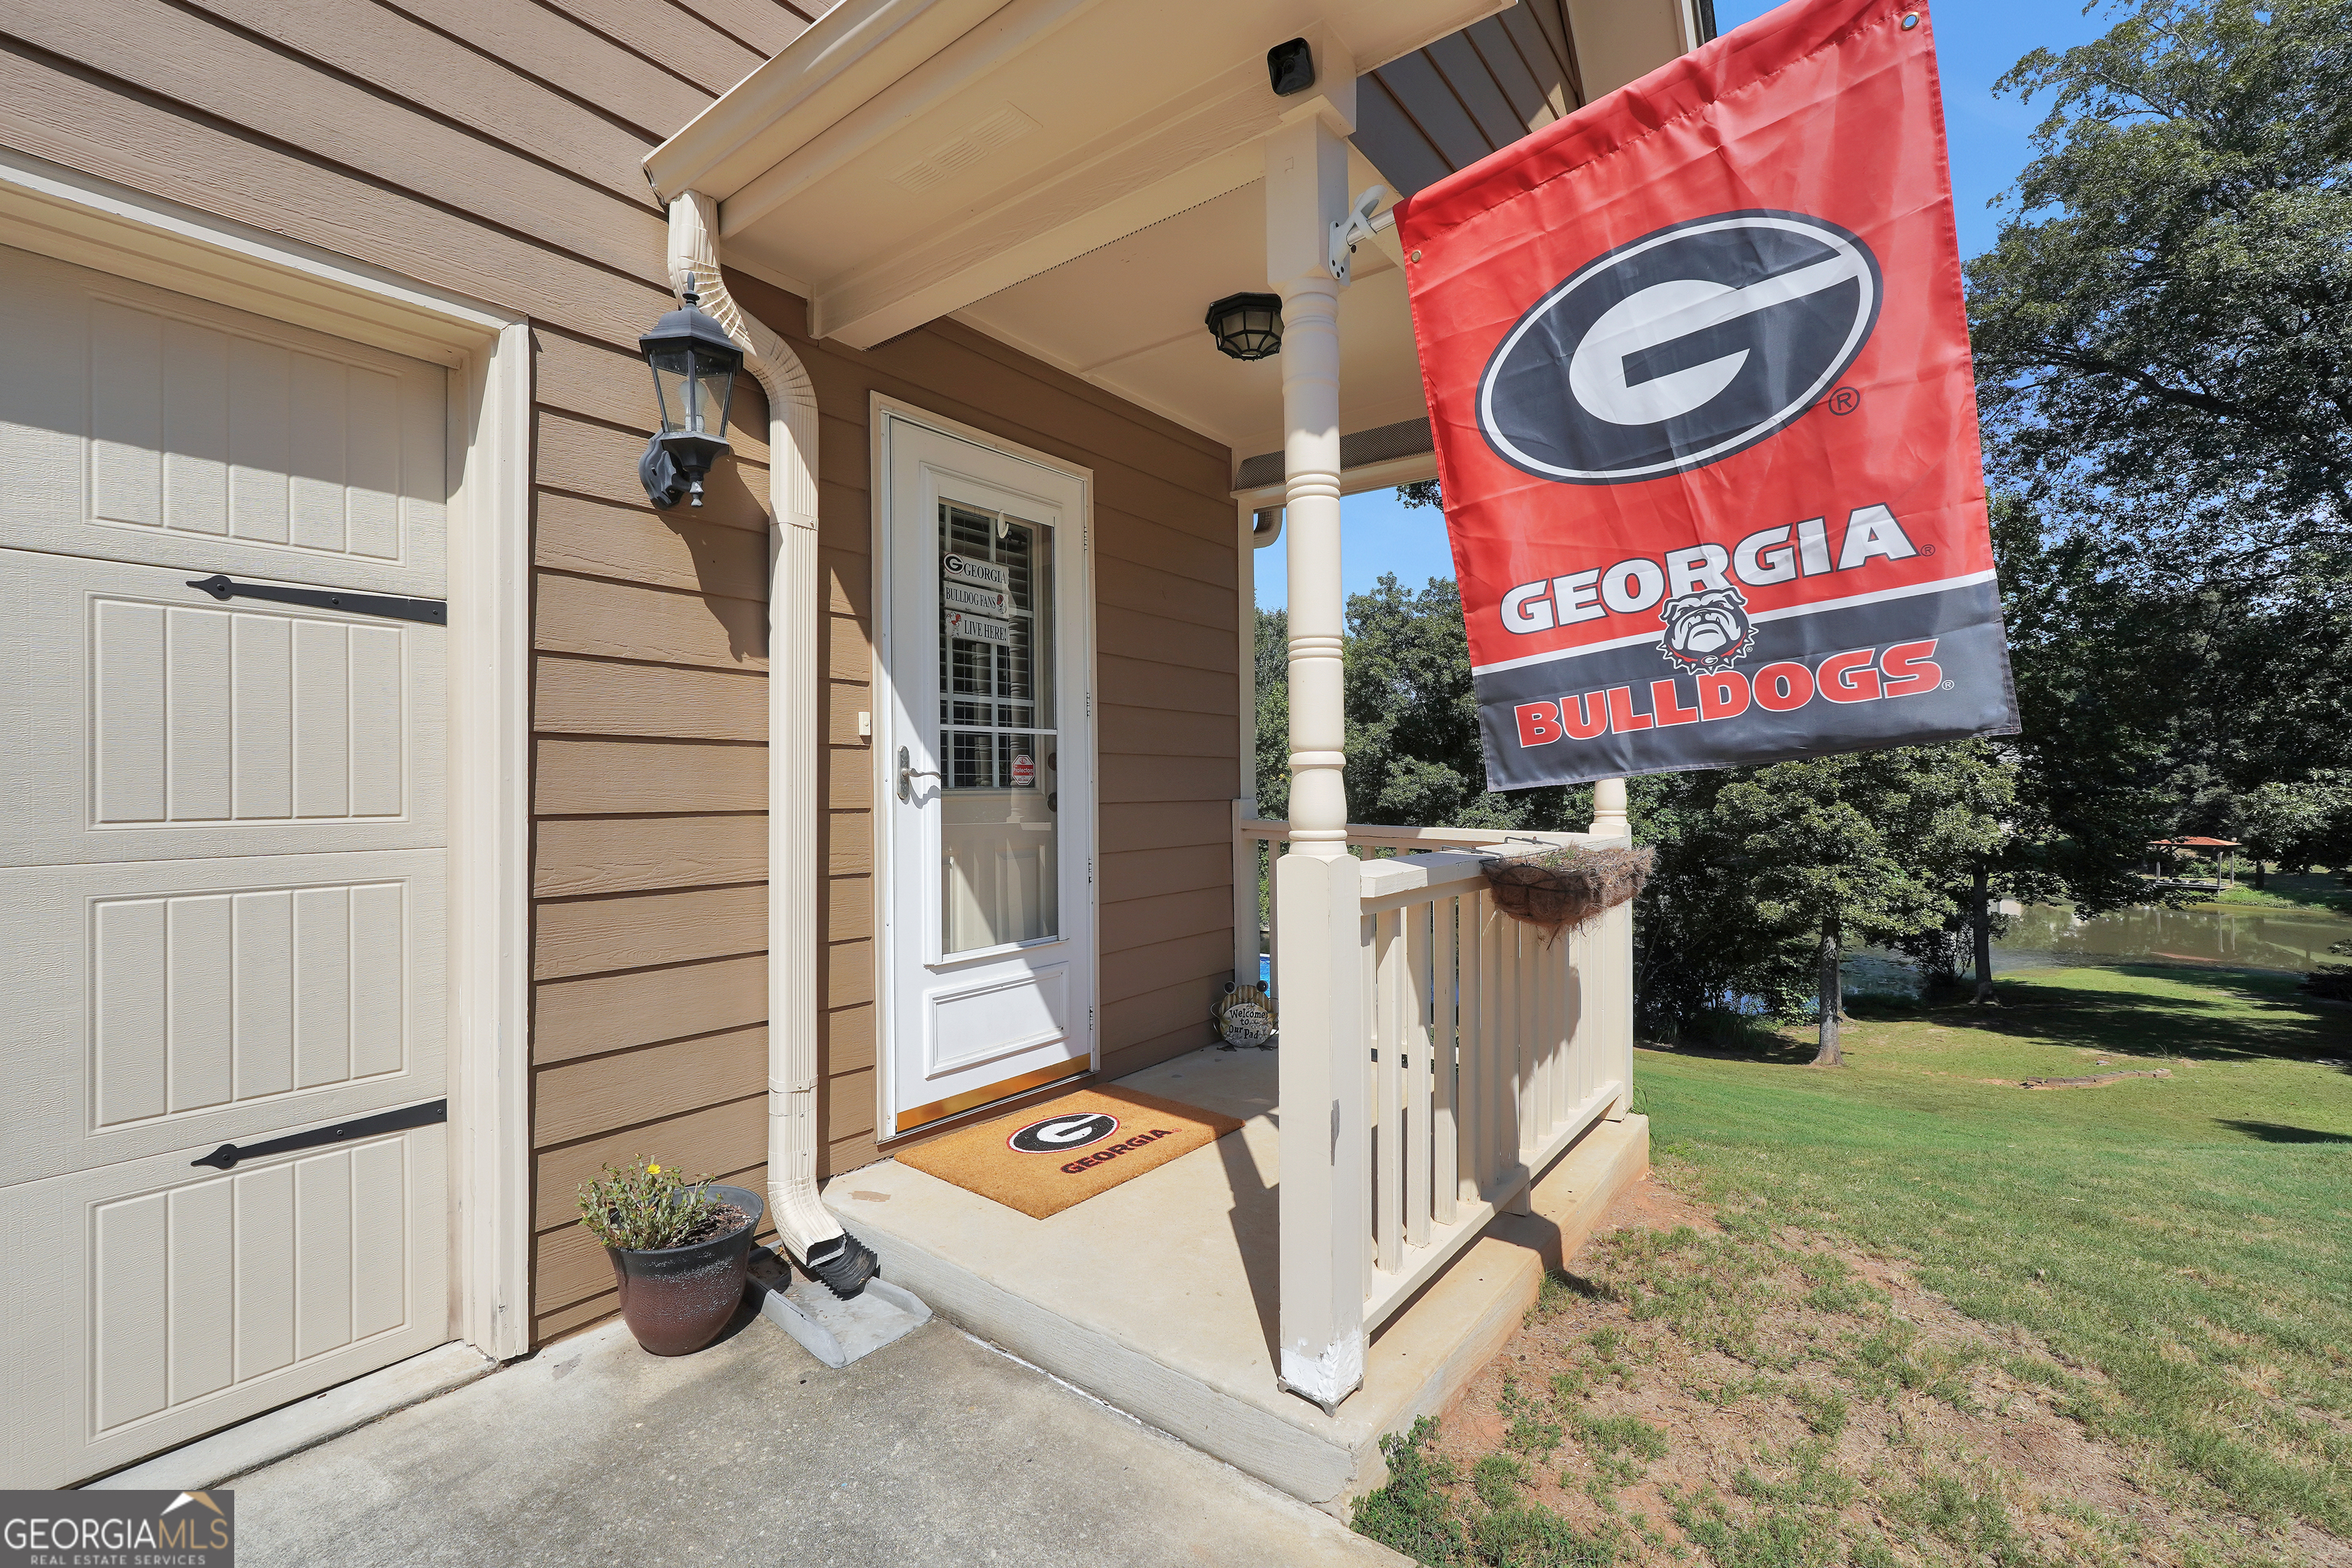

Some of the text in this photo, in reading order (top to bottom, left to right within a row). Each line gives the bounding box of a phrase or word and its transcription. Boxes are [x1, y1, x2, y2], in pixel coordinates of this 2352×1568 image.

[964, 563, 1007, 584] GEORGIA
[1501, 502, 1919, 635] GEORGIA
[946, 587, 996, 609] BULLDOG FANS
[964, 619, 1007, 641] LIVE HERE!
[1514, 639, 1945, 748] BULLDOGS
[1230, 1008, 1266, 1018] Welcome
[1229, 1024, 1259, 1039] Our Pad
[1060, 1128, 1175, 1174] GEORGIA
